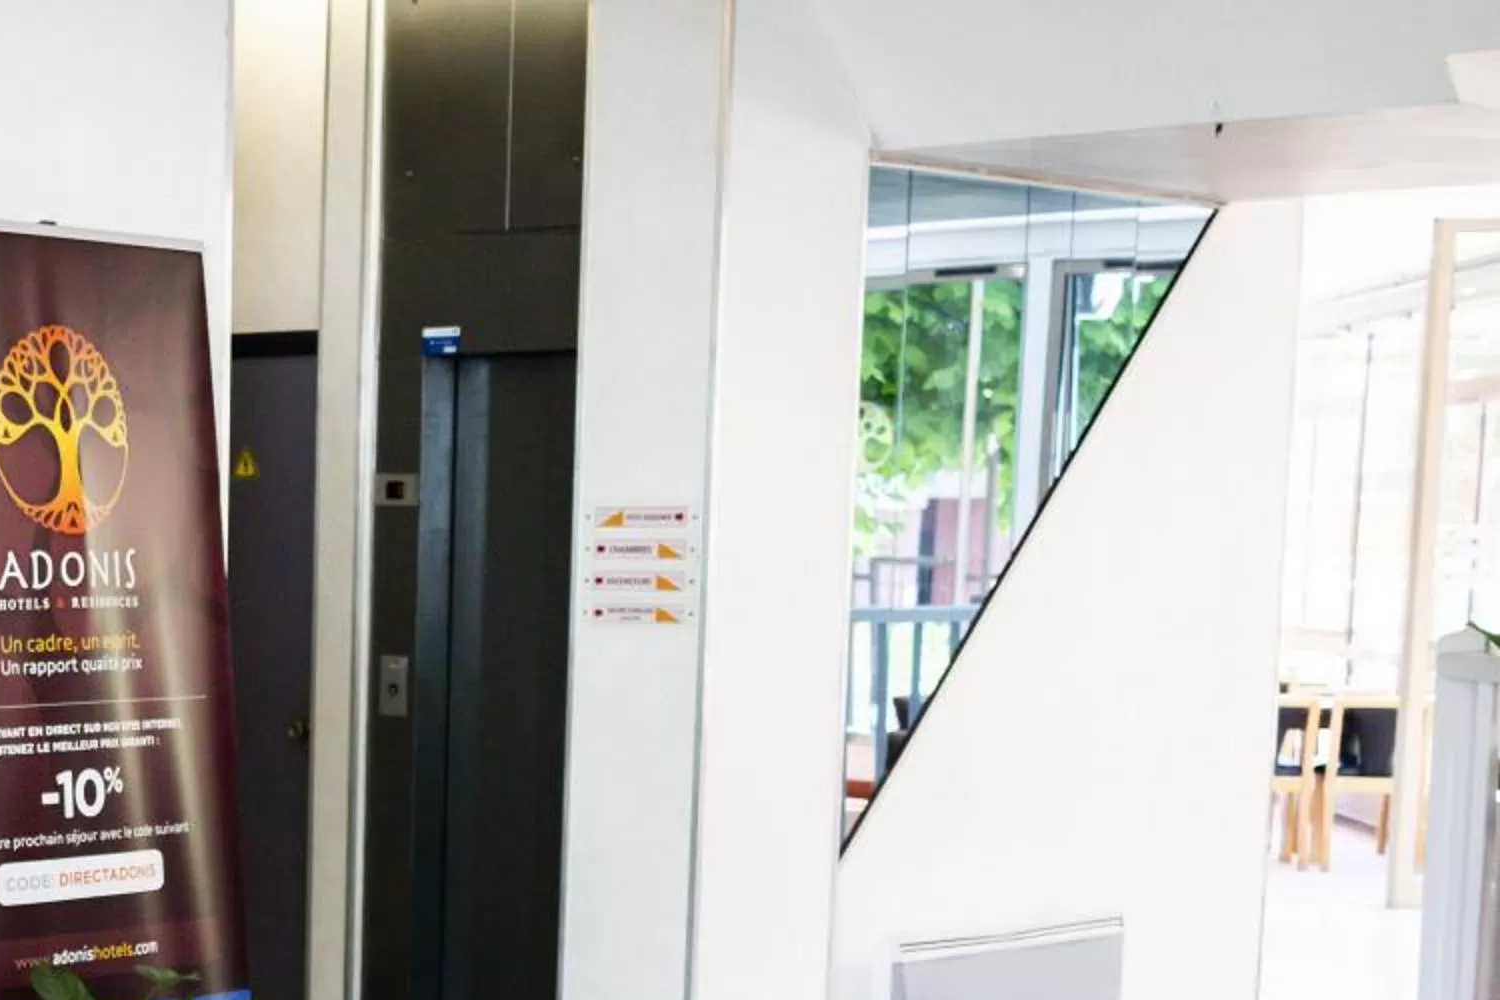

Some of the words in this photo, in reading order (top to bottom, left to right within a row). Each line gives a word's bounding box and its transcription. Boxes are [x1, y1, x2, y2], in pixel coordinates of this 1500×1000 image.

[0, 634, 23, 654] Un
[27, 632, 79, 654] cadre,
[81, 635, 100, 651] un
[0, 659, 21, 676] Un
[22, 657, 79, 678] rapport
[45, 723, 82, 737] DIRECT
[36, 742, 50, 754] LE
[52, 739, 99, 753] MEILLEUR
[13, 830, 65, 852] prochain
[66, 829, 97, 847] séjour
[99, 829, 123, 842] avec
[58, 862, 156, 888] DIRECTADONIS
